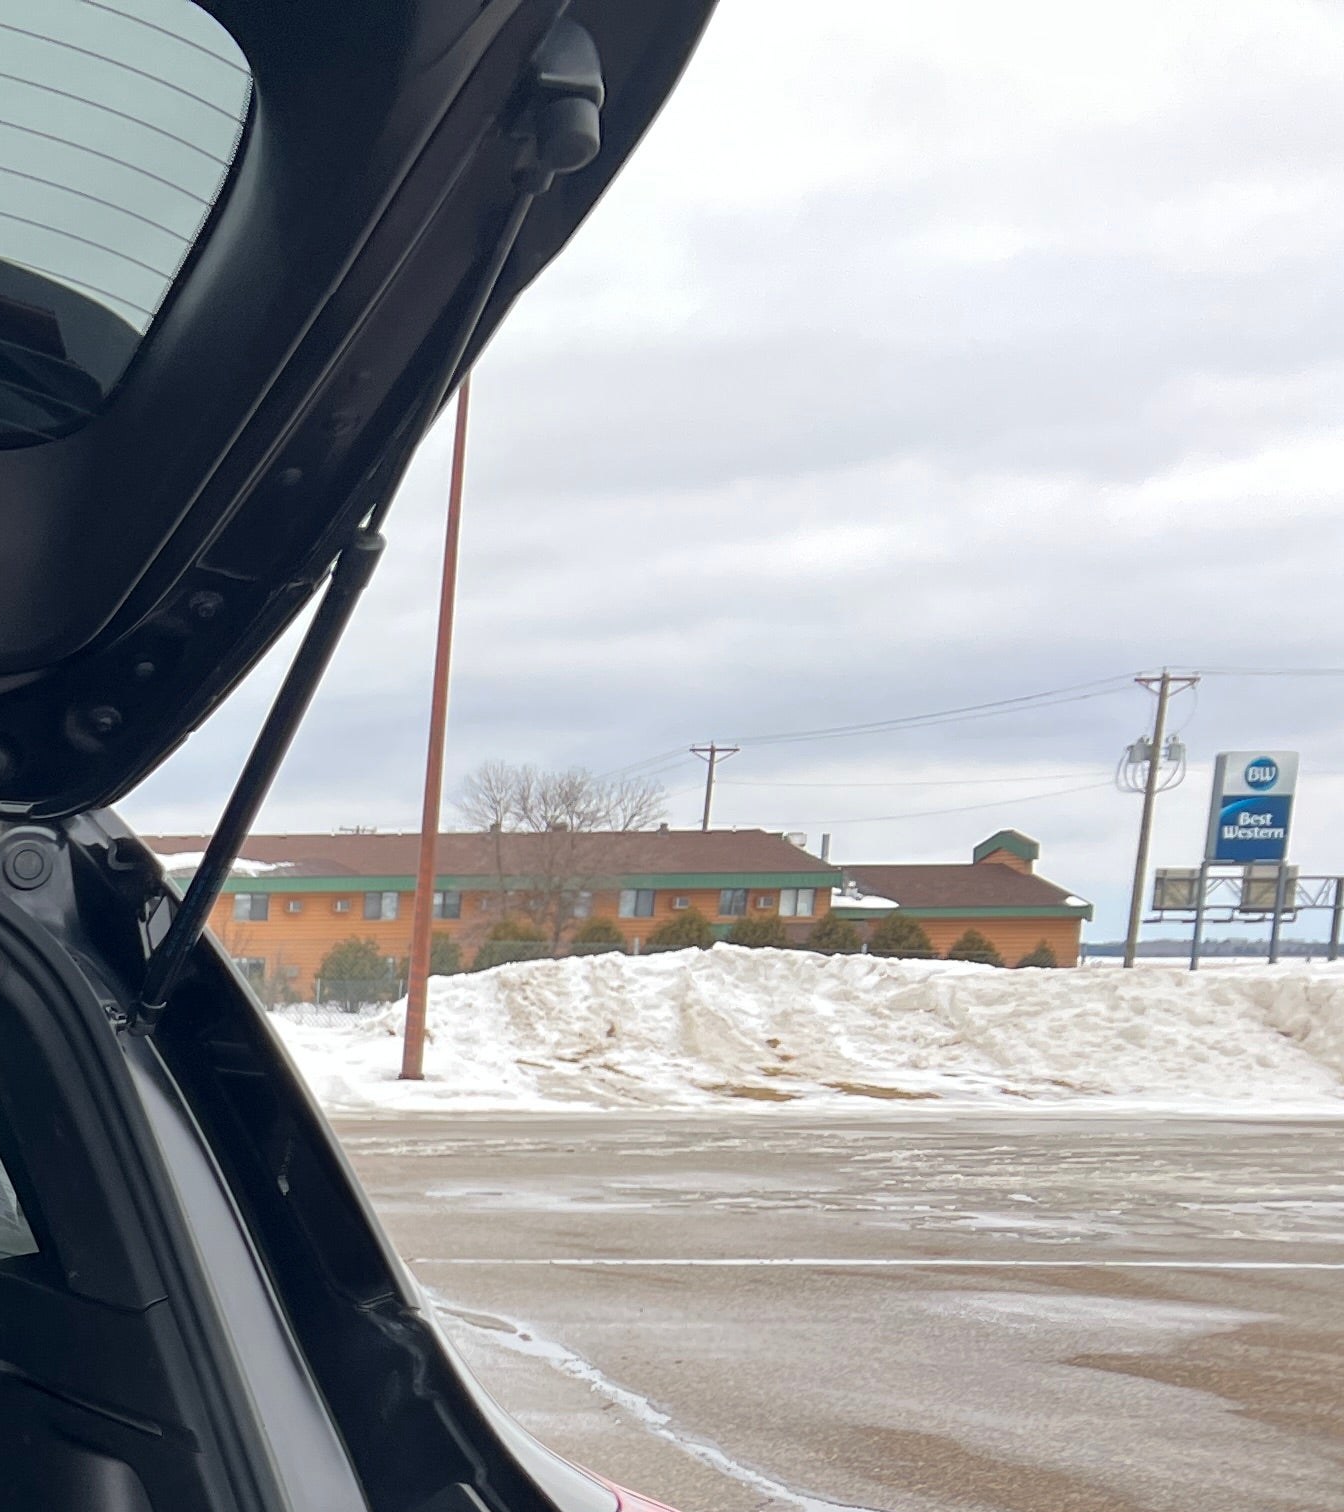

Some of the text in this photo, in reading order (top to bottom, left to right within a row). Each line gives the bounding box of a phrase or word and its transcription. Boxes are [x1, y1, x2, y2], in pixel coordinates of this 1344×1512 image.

[1248, 766, 1276, 782] BW
[1239, 812, 1273, 826] Best
[1223, 825, 1285, 839] Western
